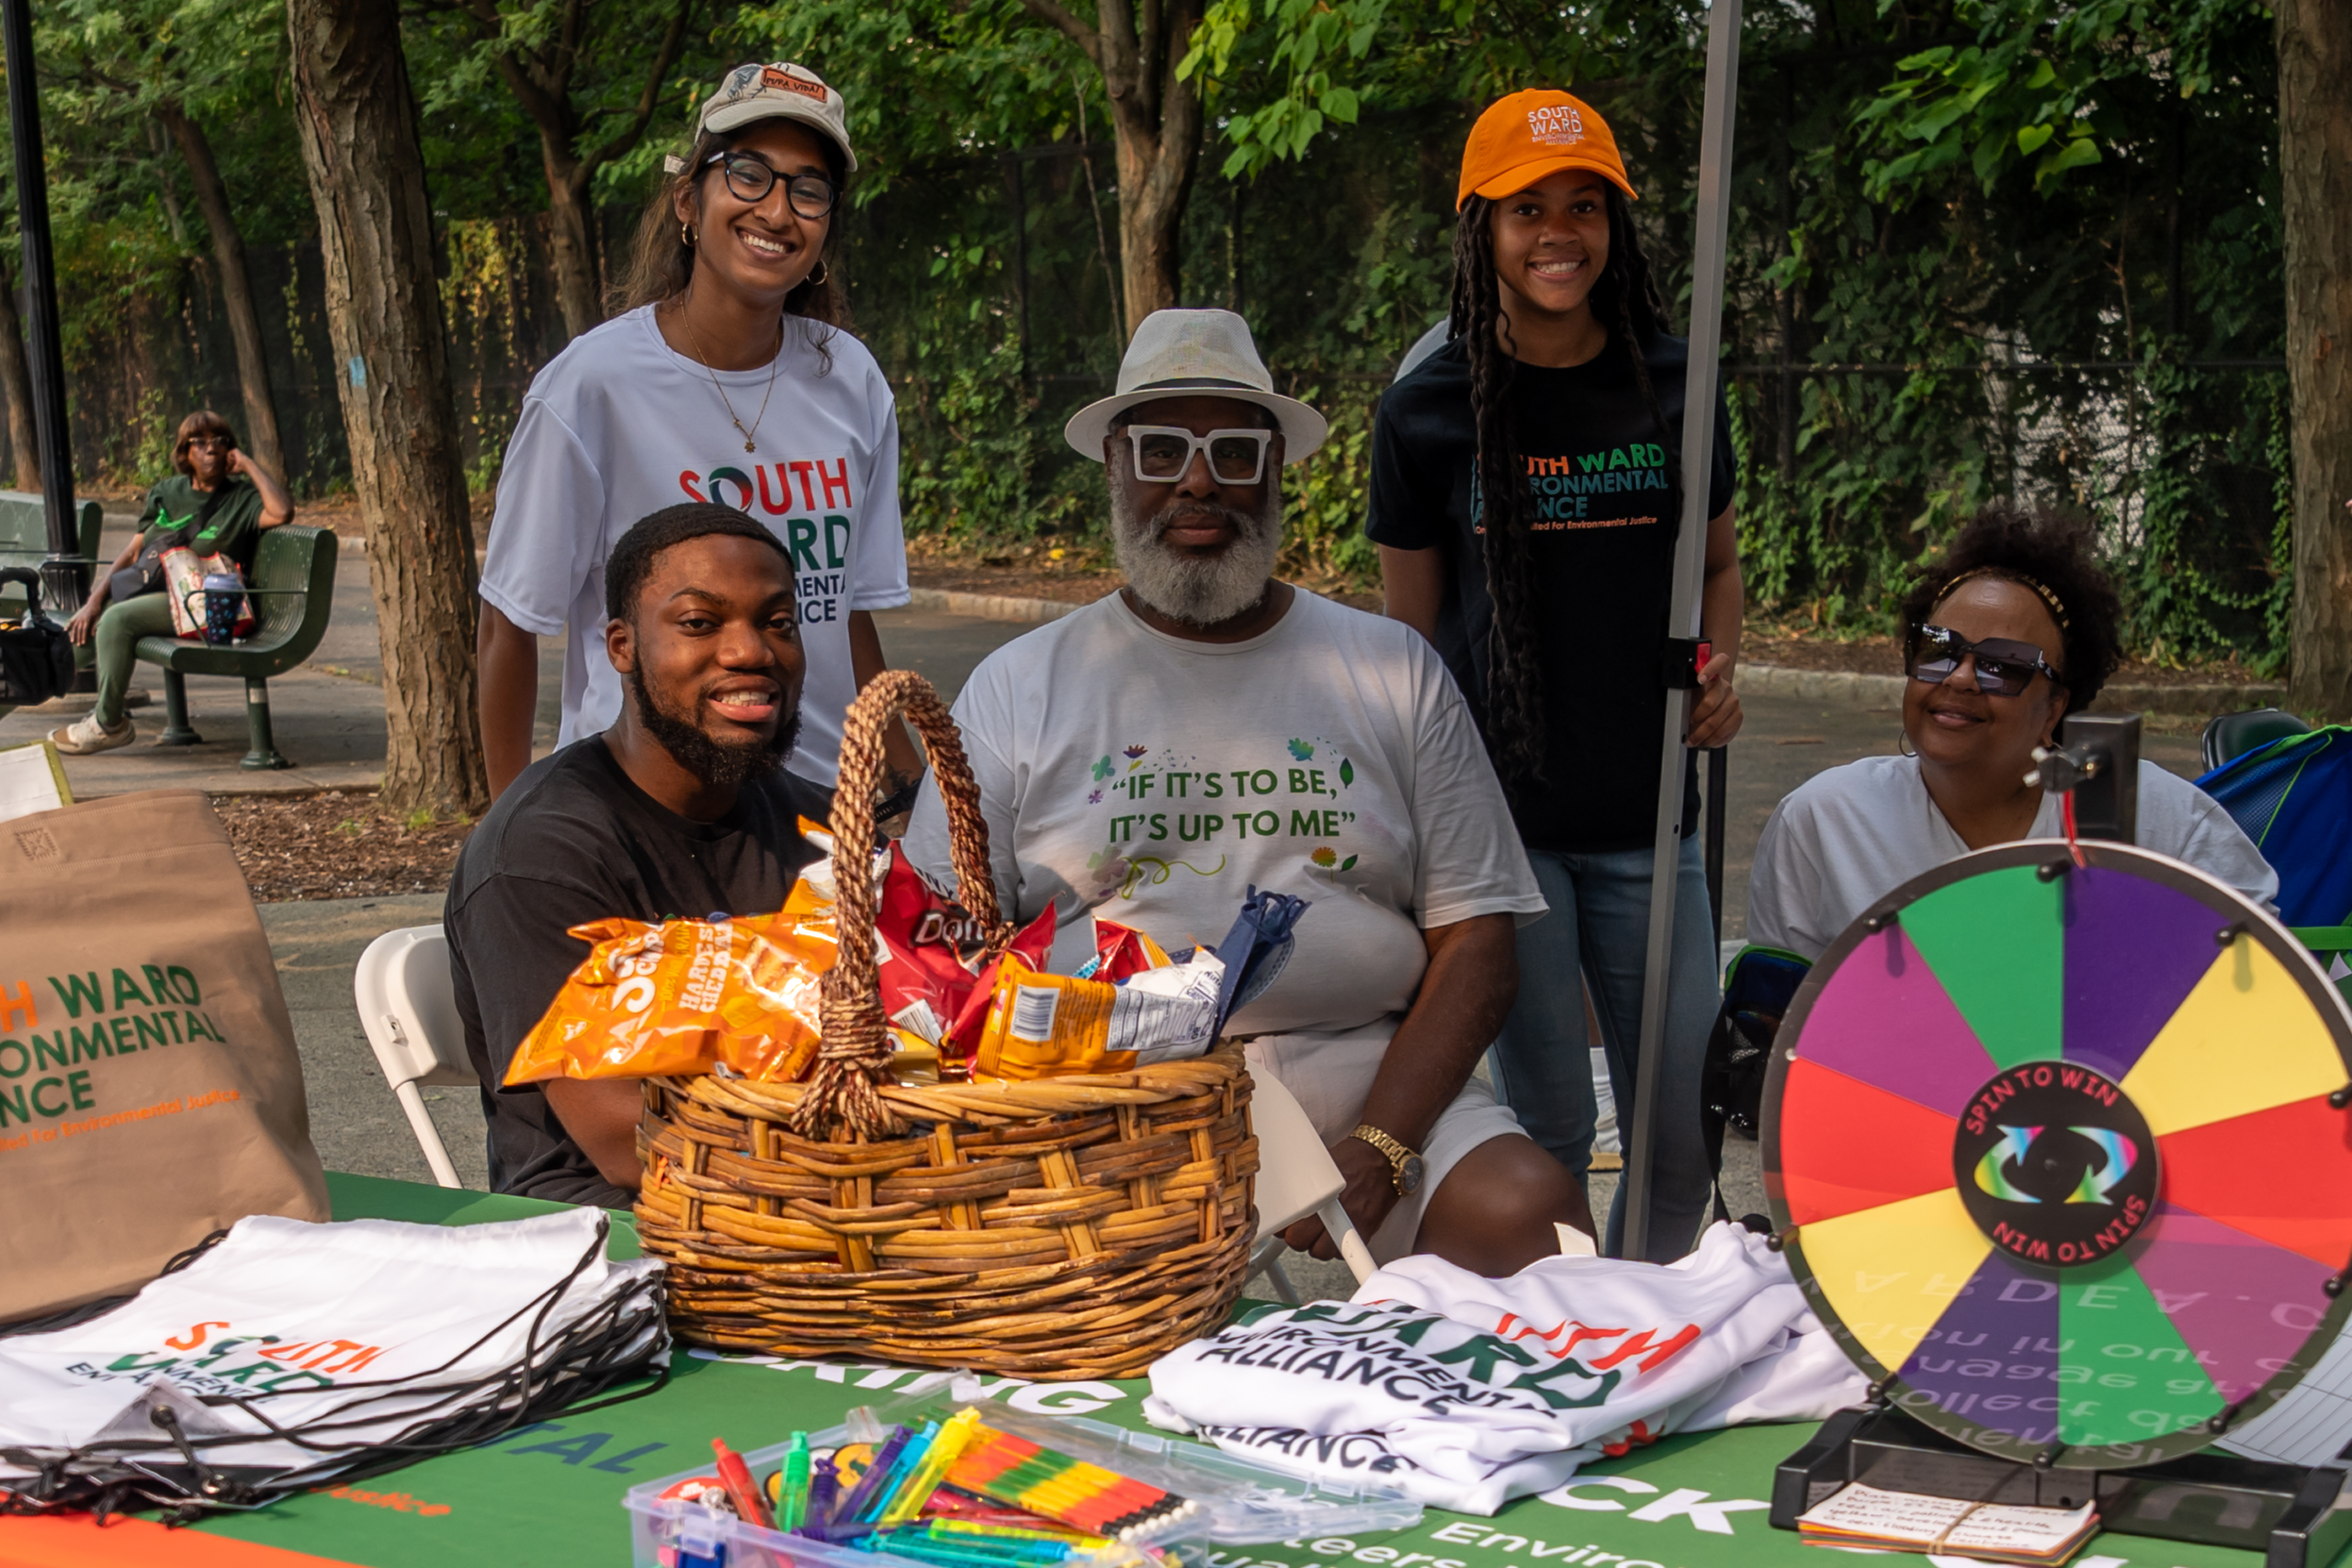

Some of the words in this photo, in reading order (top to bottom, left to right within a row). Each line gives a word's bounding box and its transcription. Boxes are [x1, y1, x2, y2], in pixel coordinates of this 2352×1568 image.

[1527, 106, 1580, 123] SOUTH
[1530, 118, 1583, 136] WARD
[1529, 469, 1668, 496] RONMENTAL
[1577, 443, 1666, 473] WARD
[679, 457, 853, 516] SOUTH
[1536, 496, 1589, 519] NCE
[786, 514, 851, 572] RD
[1566, 517, 1628, 530] Environmental
[1628, 515, 1657, 526] Justice
[1230, 768, 1278, 797] TO
[1287, 768, 1338, 801] BE,
[1178, 813, 1224, 842] UP
[1232, 810, 1281, 840] TO
[678, 922, 715, 1010] HARVES
[0, 980, 39, 1032] H
[47, 964, 201, 1019] WARD
[0, 1010, 228, 1078] ONMENTAL
[0, 1070, 96, 1128] NCE
[32, 1125, 59, 1145] For
[61, 1099, 183, 1137] Environmental
[187, 1089, 241, 1111] Justice
[1965, 1078, 2017, 1136] SPIN
[2014, 1066, 2053, 1089] TO
[2061, 1066, 2120, 1108] WIN
[1992, 1221, 2051, 1261] WIN
[2095, 1194, 2148, 1251] SPIN
[2057, 1241, 2097, 1262] TO
[1195, 1343, 1464, 1416] ALLIANCE
[1535, 1473, 1772, 1536] CK
